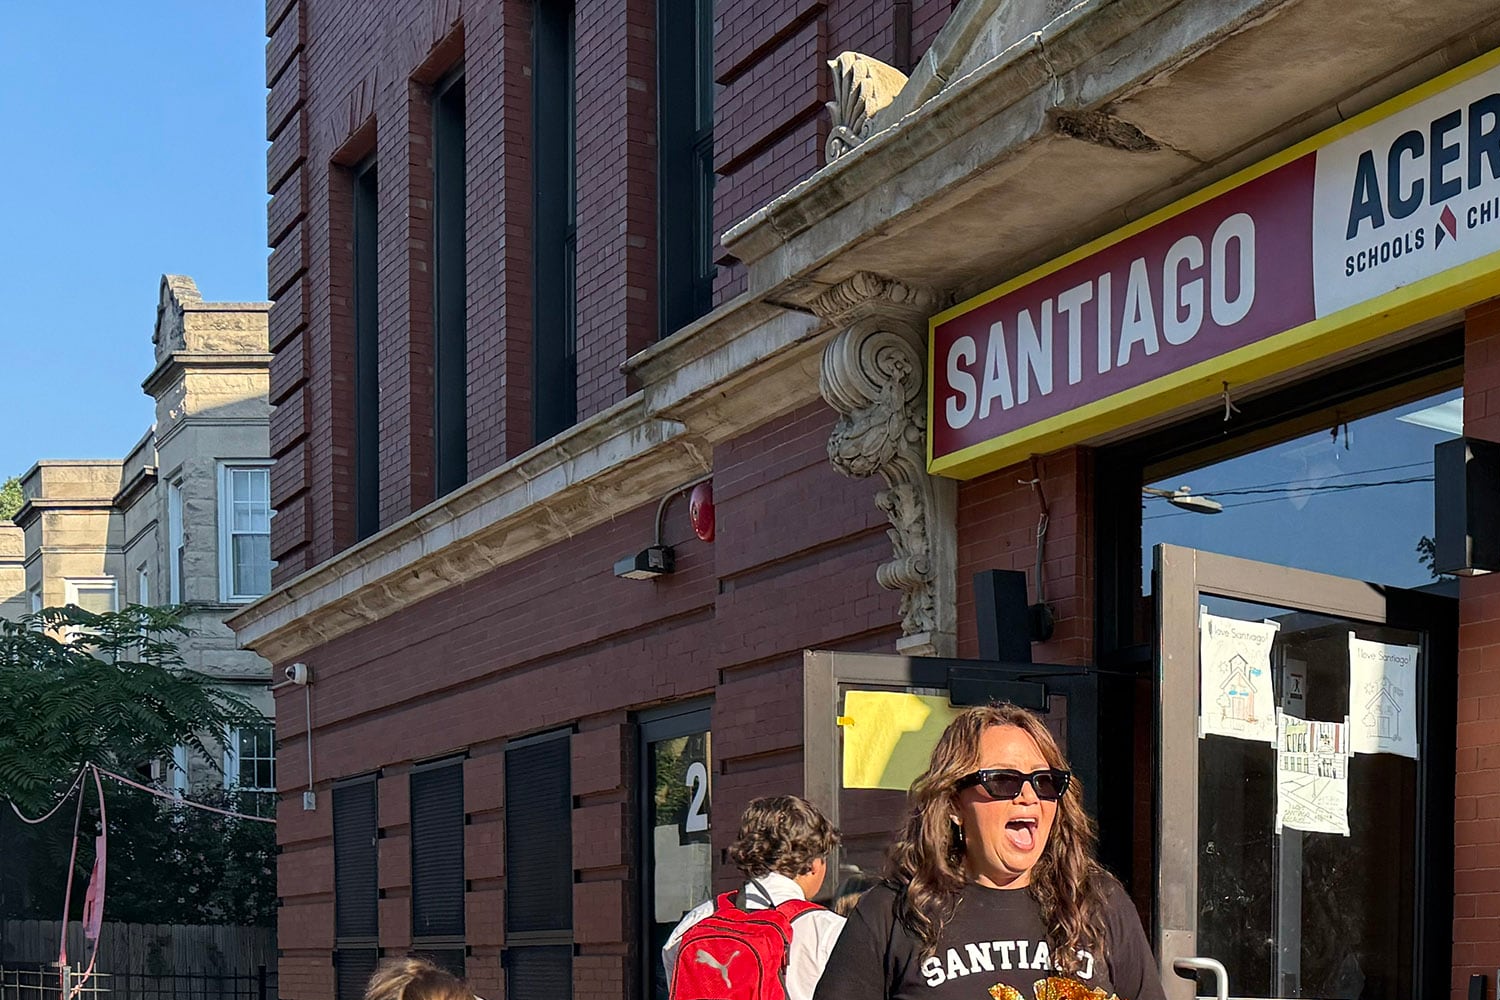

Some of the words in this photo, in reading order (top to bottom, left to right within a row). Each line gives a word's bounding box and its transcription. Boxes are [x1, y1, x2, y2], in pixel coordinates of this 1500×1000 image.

[1345, 227, 1425, 277] SCHOOLS
[945, 212, 1256, 430] SANTIAGO
[1214, 625, 1230, 638] love
[685, 761, 709, 833] 2
[921, 939, 1095, 988] SANTIAO
